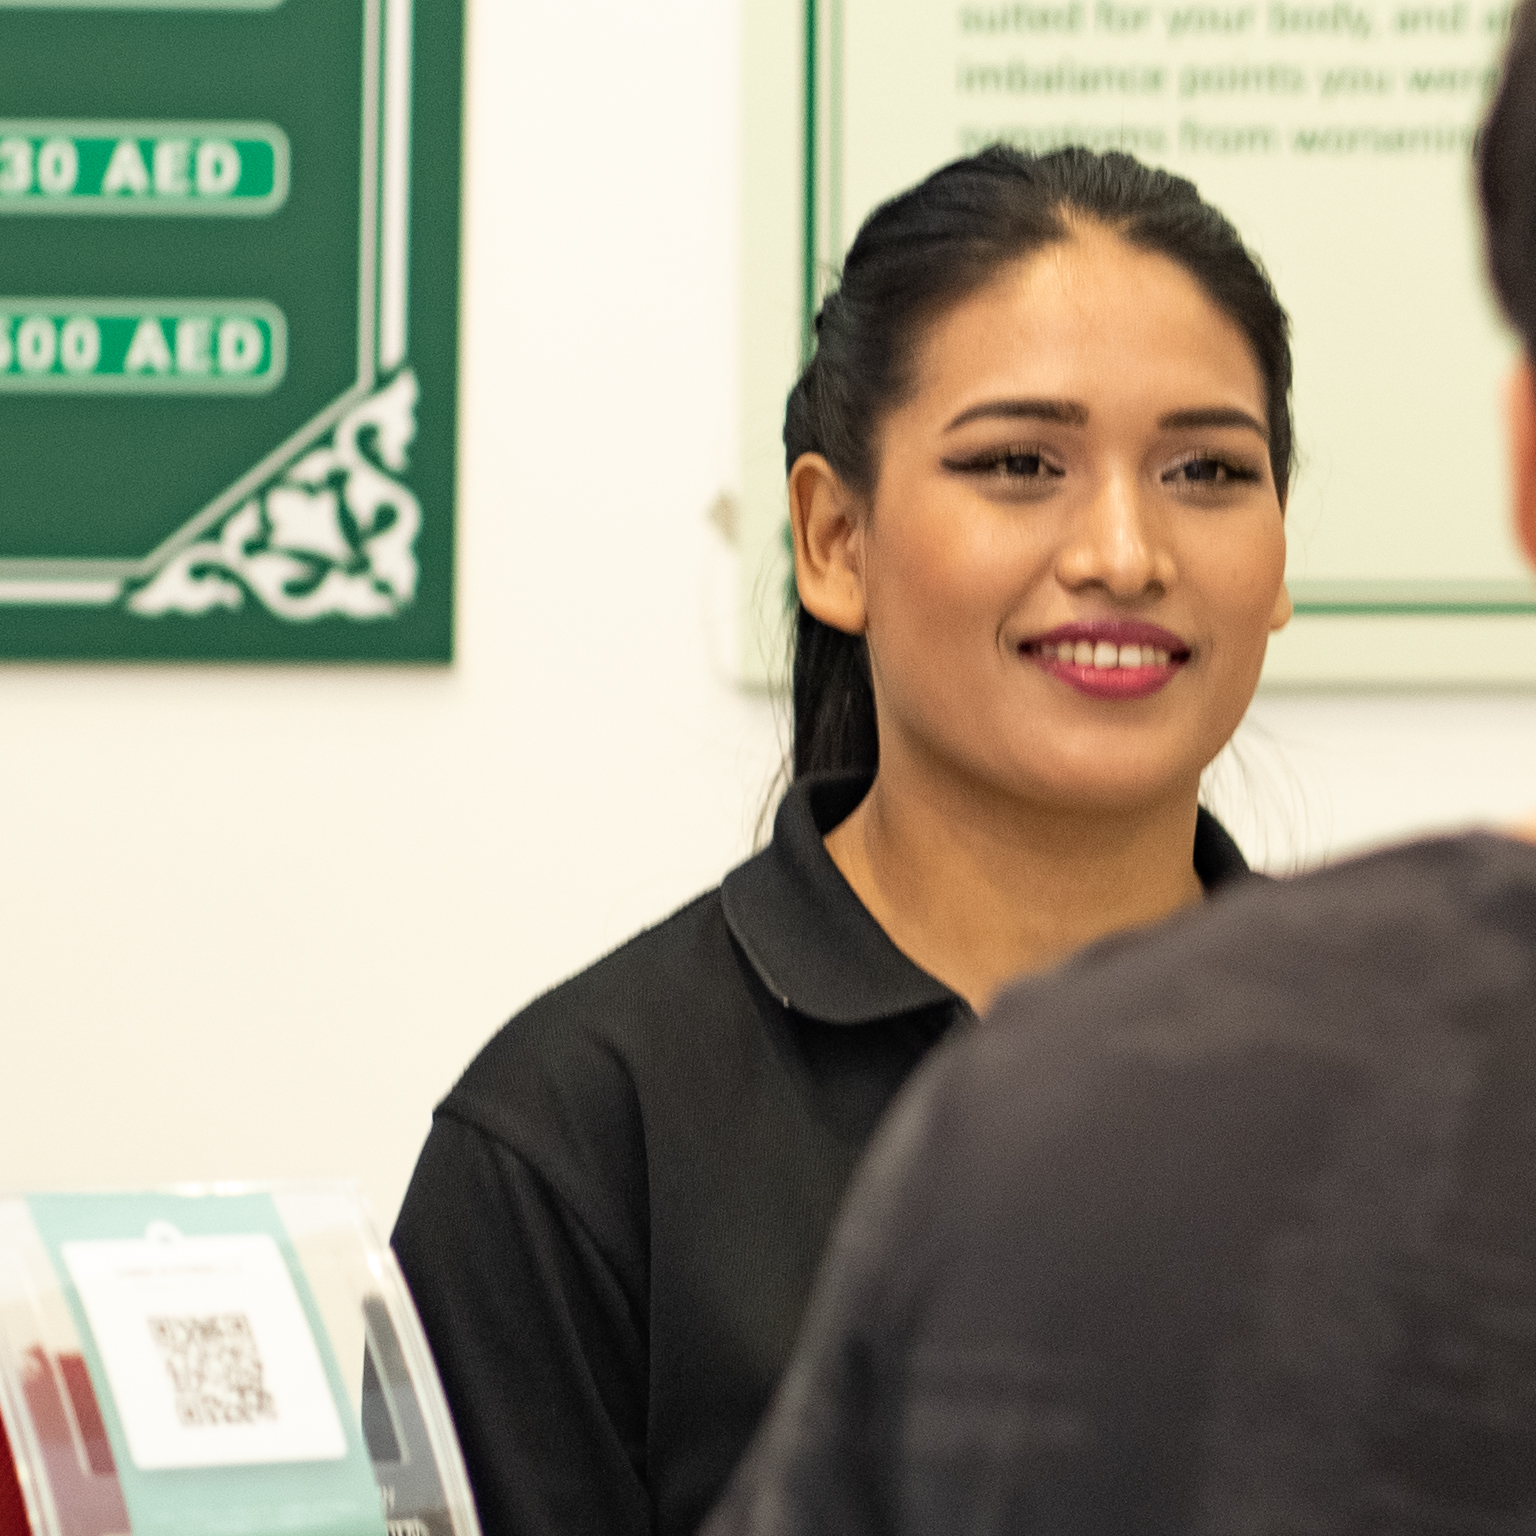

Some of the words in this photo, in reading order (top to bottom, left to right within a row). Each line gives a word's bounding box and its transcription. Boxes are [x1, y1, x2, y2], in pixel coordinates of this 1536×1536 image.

[1164, 4, 1257, 40] your
[1391, 0, 1470, 37] and
[956, 57, 1168, 96] imbalance
[1178, 61, 1307, 101] points
[1316, 65, 1395, 101] you
[1177, 116, 1278, 154] from
[101, 139, 242, 196] AED
[123, 317, 265, 374] AED
